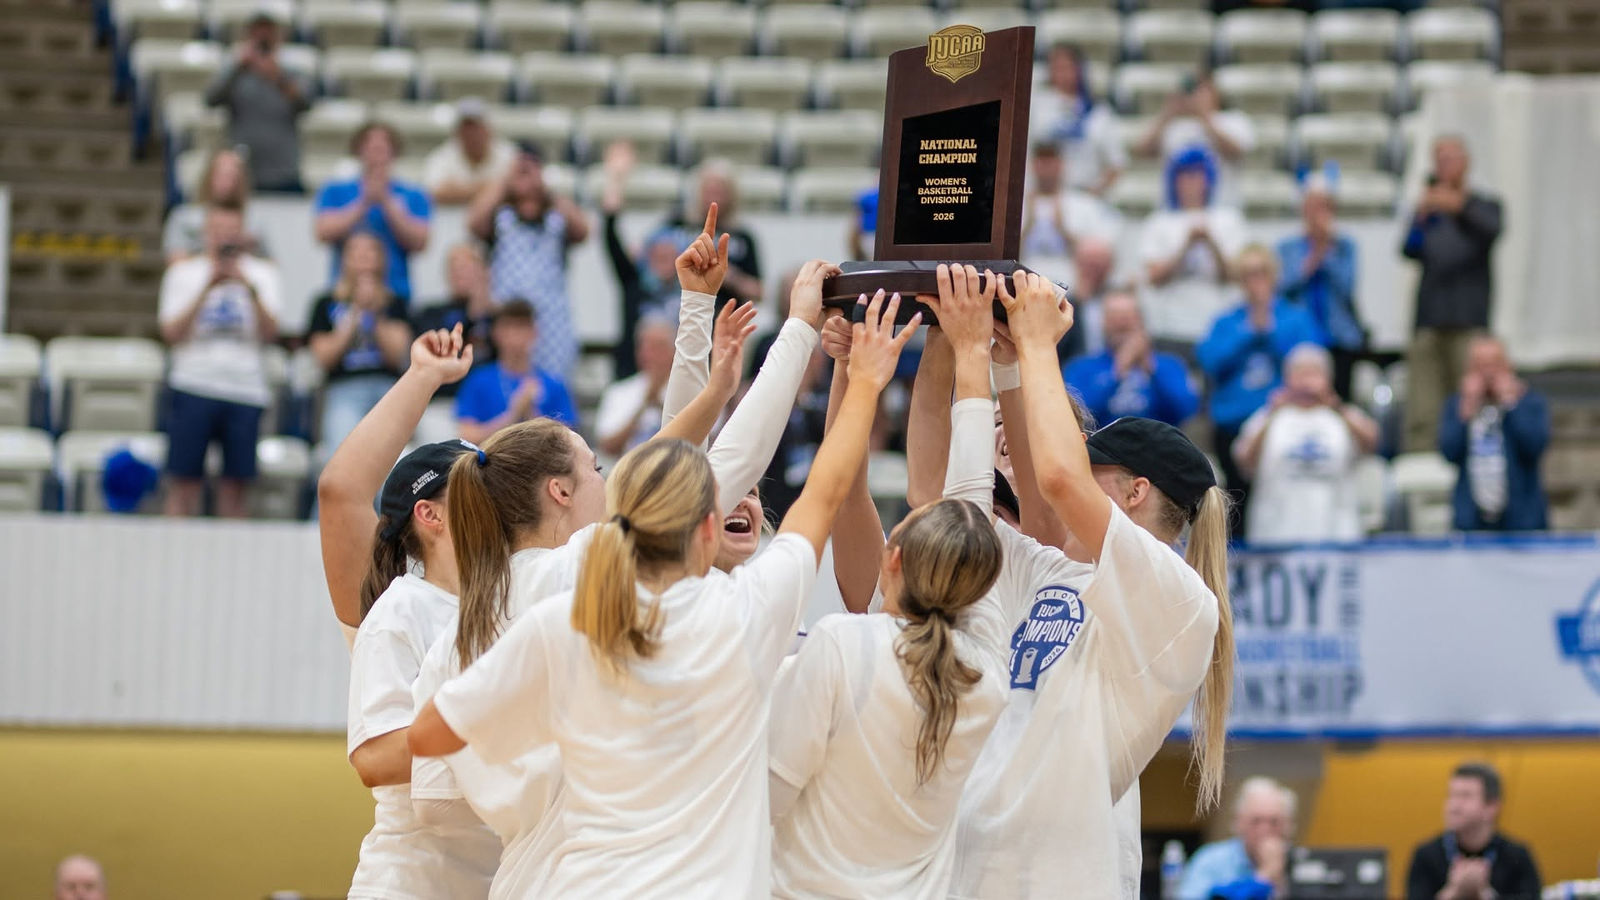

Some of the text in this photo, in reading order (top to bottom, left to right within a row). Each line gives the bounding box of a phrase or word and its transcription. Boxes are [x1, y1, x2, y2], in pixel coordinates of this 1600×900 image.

[929, 34, 983, 63] NJCAA
[920, 139, 977, 150] NATIONAL
[919, 153, 977, 164] CHAMPION
[925, 178, 967, 186] WOMEN'S
[918, 187, 973, 195] BASKETBALL
[921, 196, 969, 204] DIVISION III
[933, 213, 955, 221] 2026
[1022, 619, 1082, 644] MPIONS
